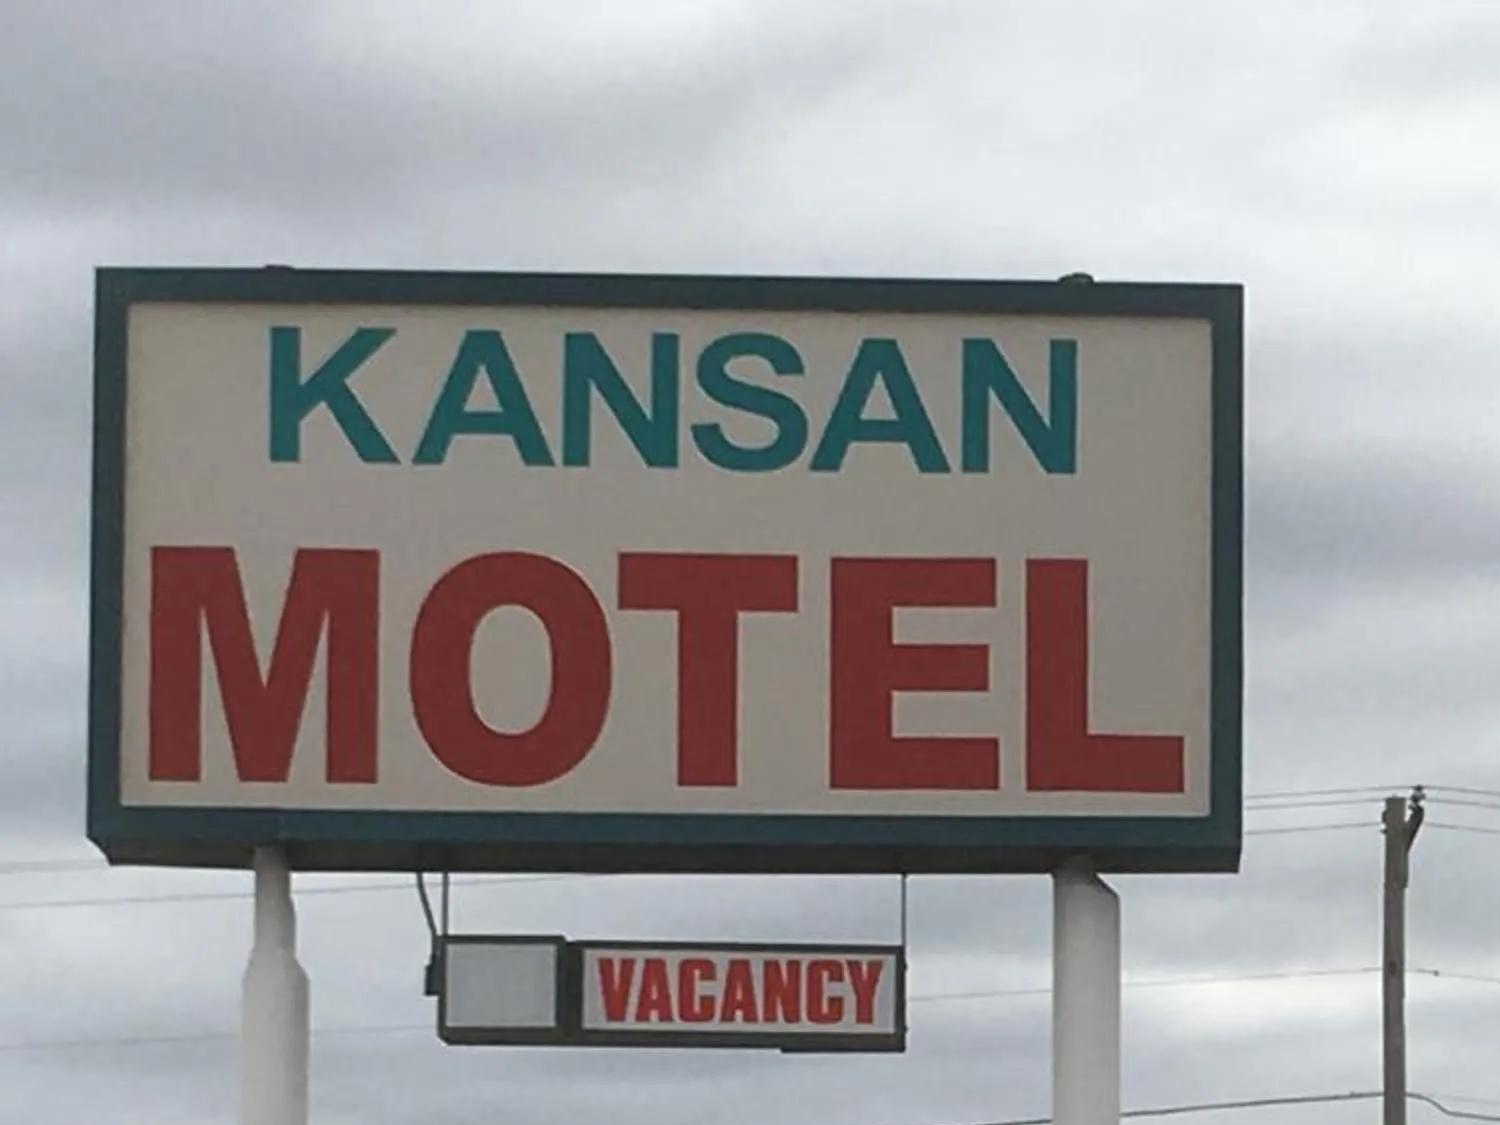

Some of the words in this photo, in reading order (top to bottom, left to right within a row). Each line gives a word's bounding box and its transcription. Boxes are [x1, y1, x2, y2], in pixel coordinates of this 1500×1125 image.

[267, 325, 1079, 475] KANSAN
[147, 545, 1187, 794] MOTEL
[597, 956, 884, 1025] VACANCY
